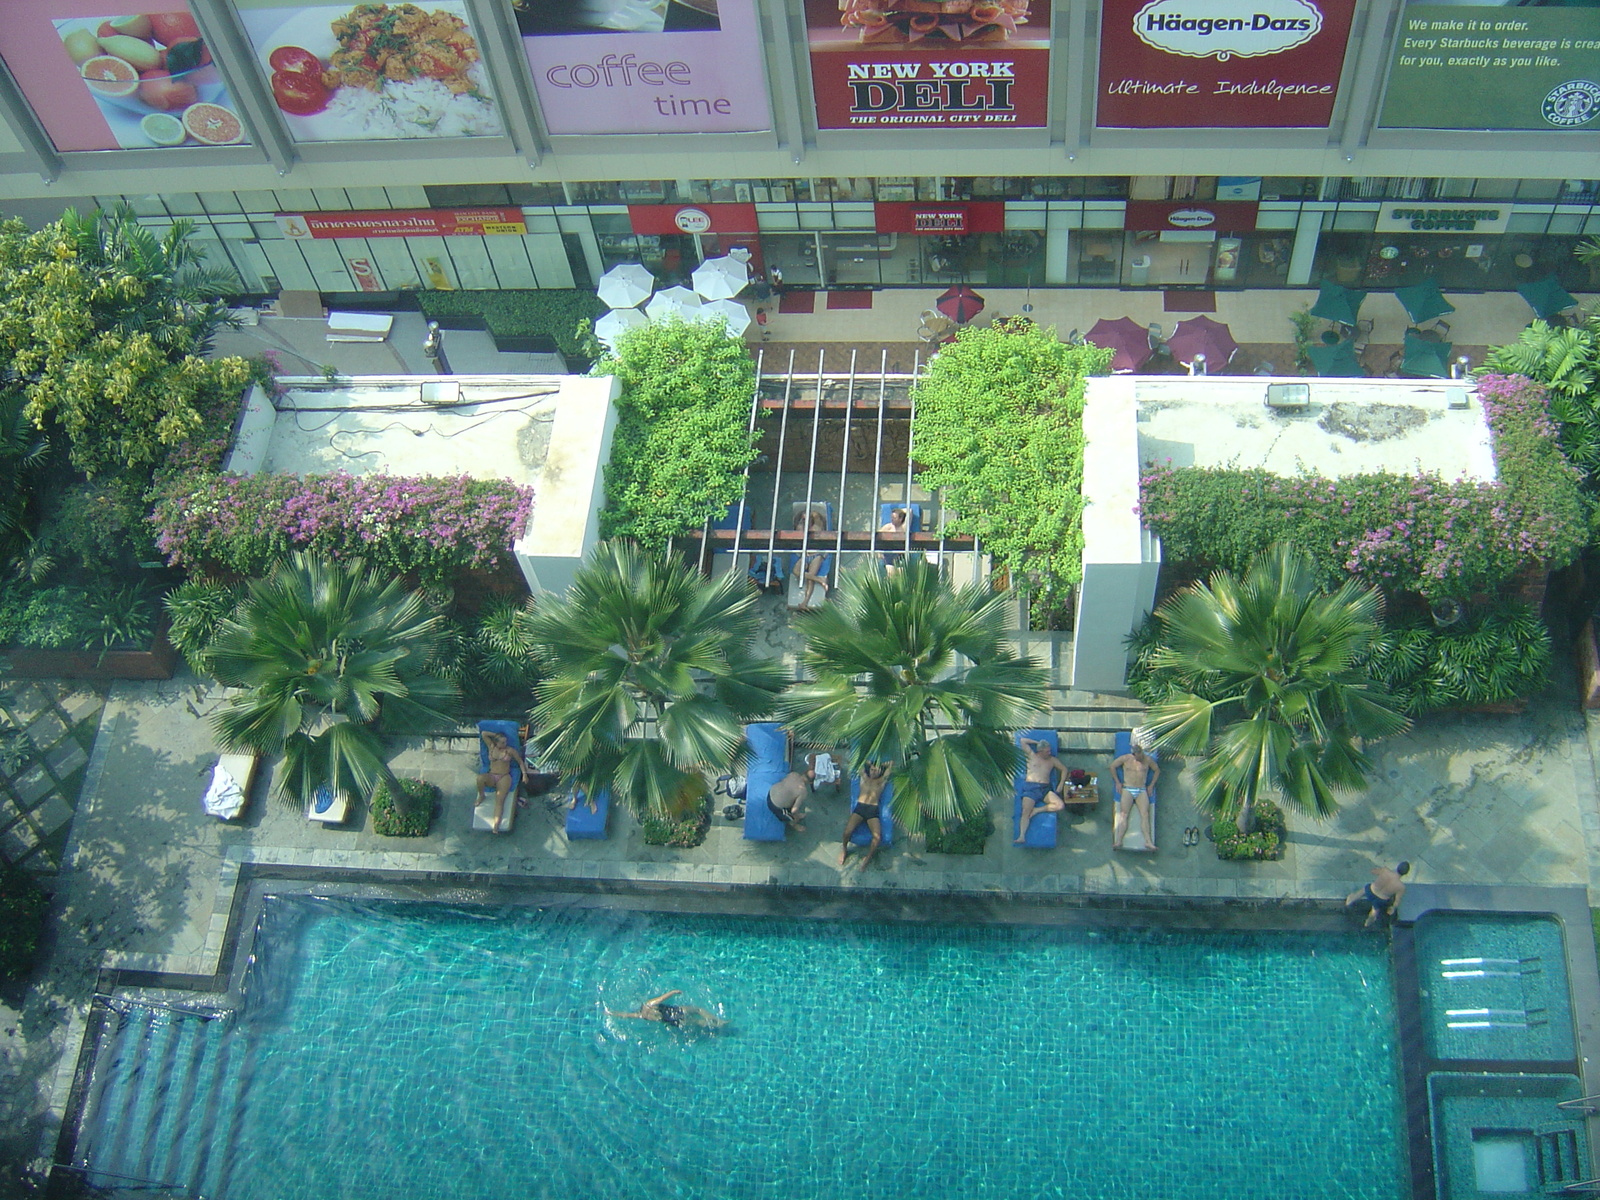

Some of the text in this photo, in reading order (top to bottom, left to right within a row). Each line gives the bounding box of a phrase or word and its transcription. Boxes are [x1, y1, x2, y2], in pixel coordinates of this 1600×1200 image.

[1146, 13, 1311, 36] Häagen-Dazs
[1408, 19, 1529, 31] We make it to order.
[1403, 37, 1436, 50] Every
[1439, 37, 1499, 49] Starbucks
[1502, 38, 1557, 51] beverage
[1560, 38, 1571, 49] is
[1399, 55, 1561, 69] for you, exactly as you like.
[546, 53, 691, 88] coffee
[847, 62, 1015, 79] NEW YORK
[847, 78, 1015, 112] DELI
[1107, 79, 1334, 101] Ultimate Indulgence
[1547, 82, 1600, 103] STARBUCKS
[654, 94, 731, 116] time
[849, 114, 1017, 124] THE ORIGINAL CITY DELI
[1547, 112, 1590, 125] COFFEE
[1391, 209, 1499, 220] STARBUCKS
[915, 218, 964, 228] DELI
[1411, 219, 1476, 230] COFFEE
